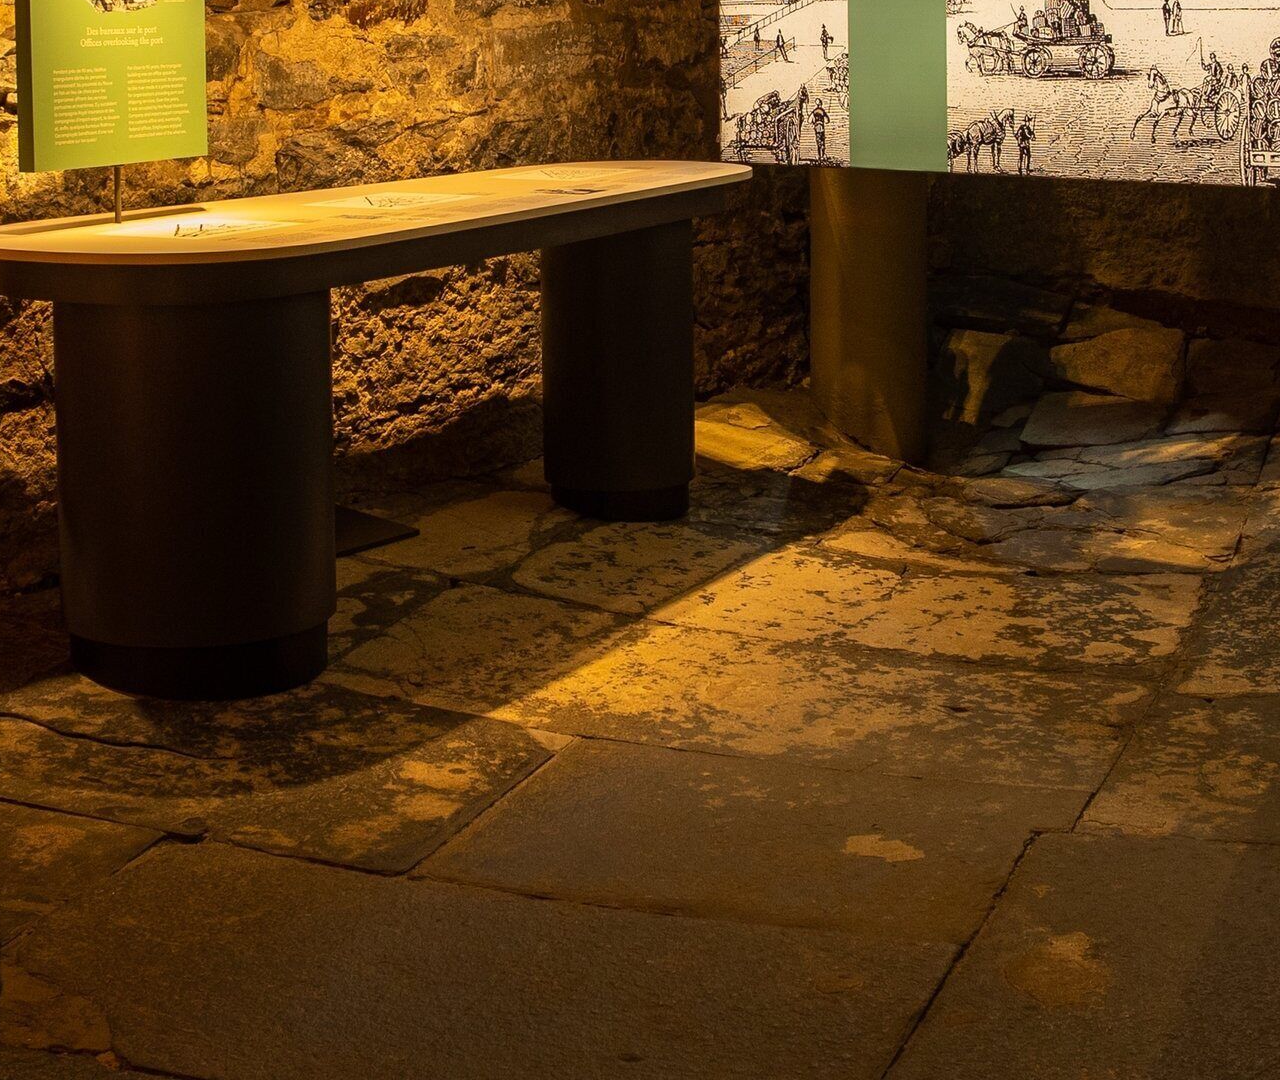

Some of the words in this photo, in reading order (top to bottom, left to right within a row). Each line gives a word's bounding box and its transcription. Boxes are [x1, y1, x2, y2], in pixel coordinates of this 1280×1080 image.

[86, 27, 98, 35] Des
[100, 27, 125, 35] bureaux
[144, 26, 157, 36] port
[80, 38, 102, 47] Offices
[103, 37, 139, 47] overlooking
[140, 36, 149, 45] the
[150, 37, 163, 46] port
